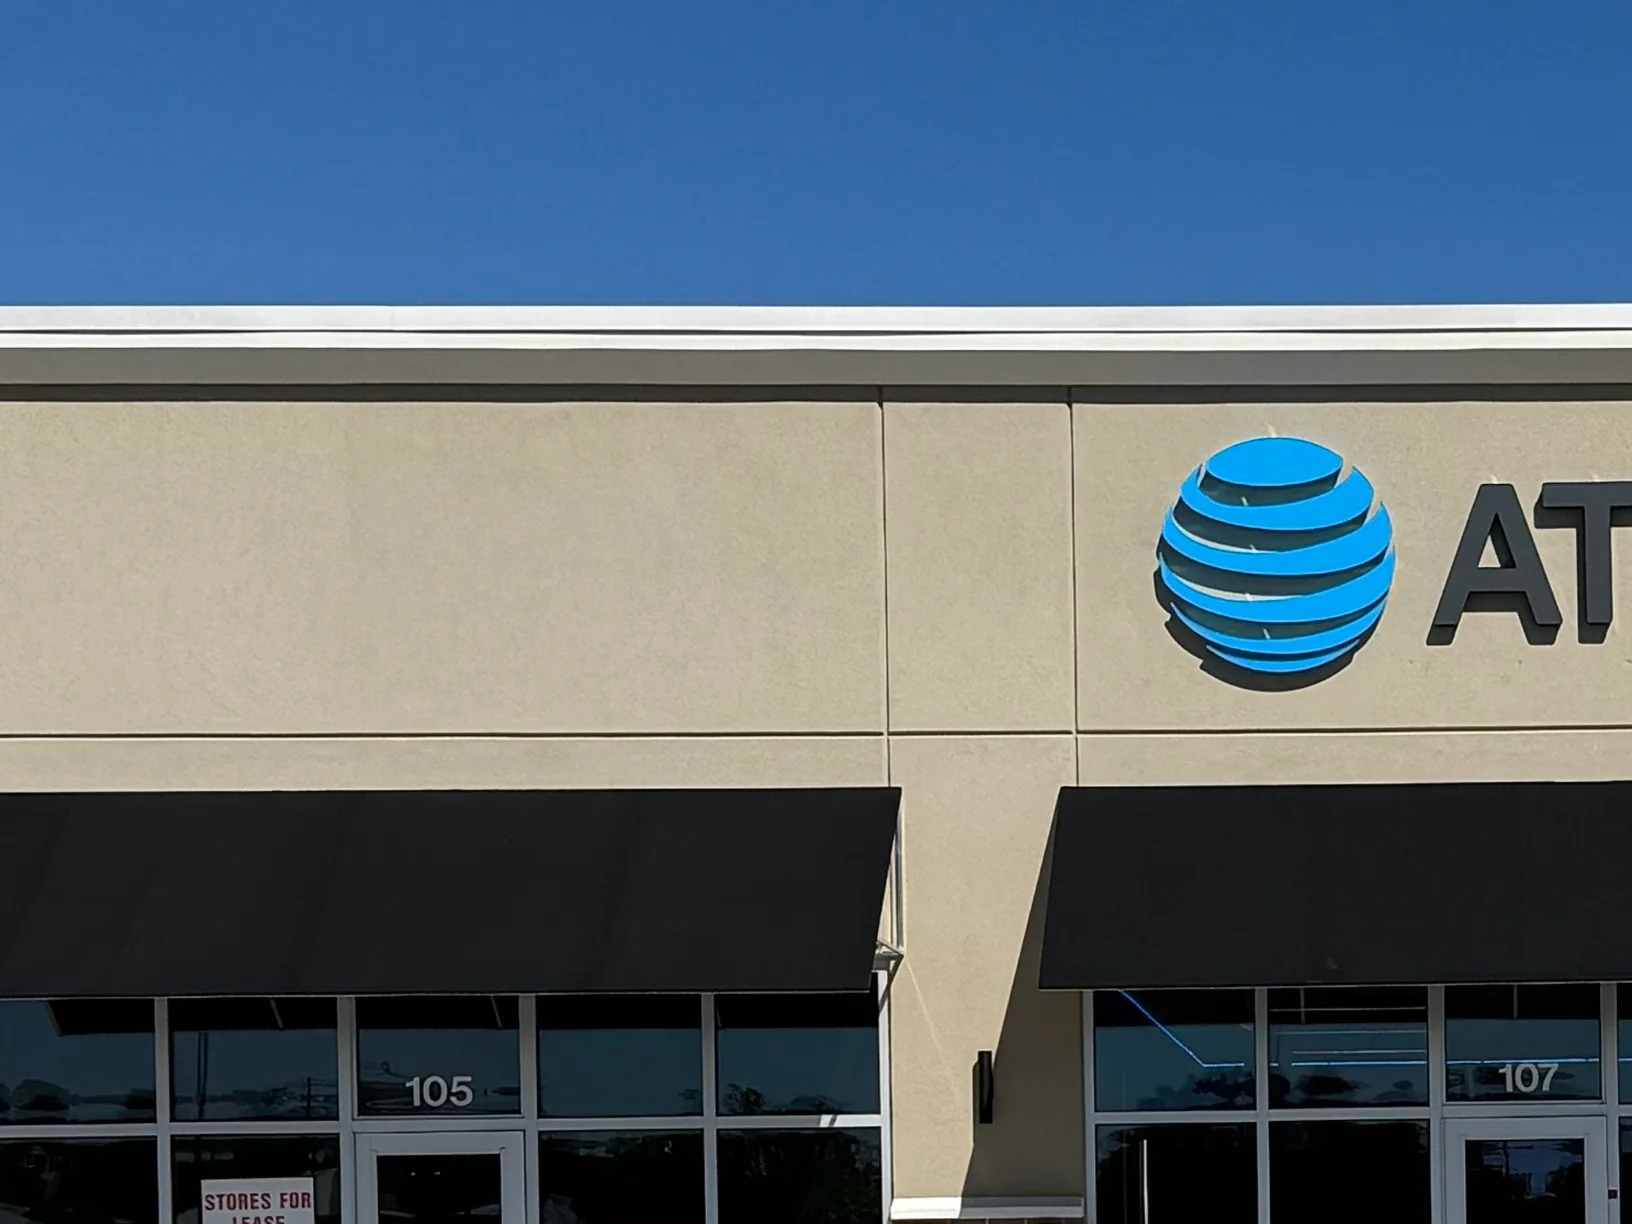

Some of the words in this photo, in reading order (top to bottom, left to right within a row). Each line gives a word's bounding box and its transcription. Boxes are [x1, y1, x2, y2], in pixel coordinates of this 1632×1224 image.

[405, 1075, 473, 1107] 105
[1498, 1063, 1559, 1093] 107
[204, 1193, 272, 1211] STORES
[279, 1192, 312, 1209] FOR
